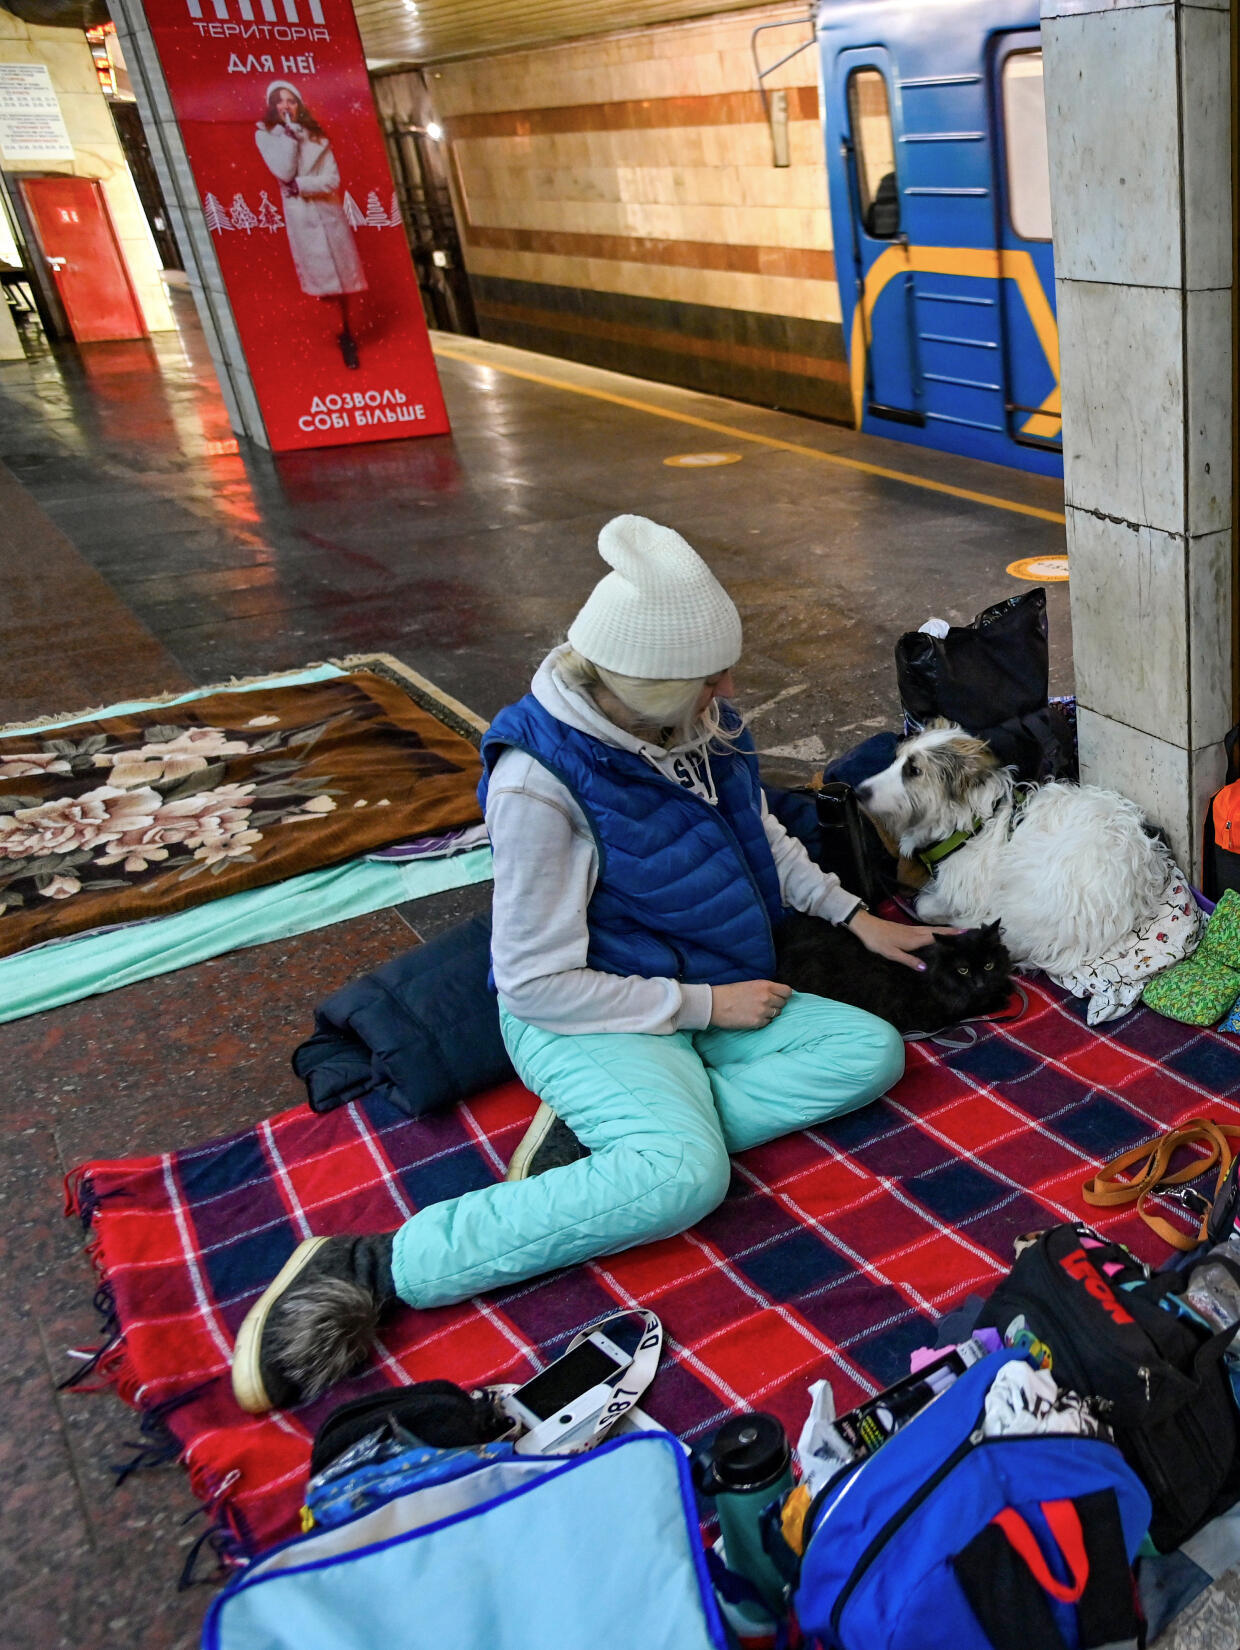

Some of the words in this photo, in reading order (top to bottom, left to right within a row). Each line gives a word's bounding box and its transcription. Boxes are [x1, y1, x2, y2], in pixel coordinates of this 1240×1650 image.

[193, 22, 330, 42] ТЕРИТОРІЯ
[227, 52, 275, 74] ДЛЯ
[281, 52, 316, 74] НЕЇ
[311, 388, 407, 414] ДОЗВОЛЬ
[298, 411, 350, 432] СОБІ
[355, 404, 426, 426] БІЛЬШЕ
